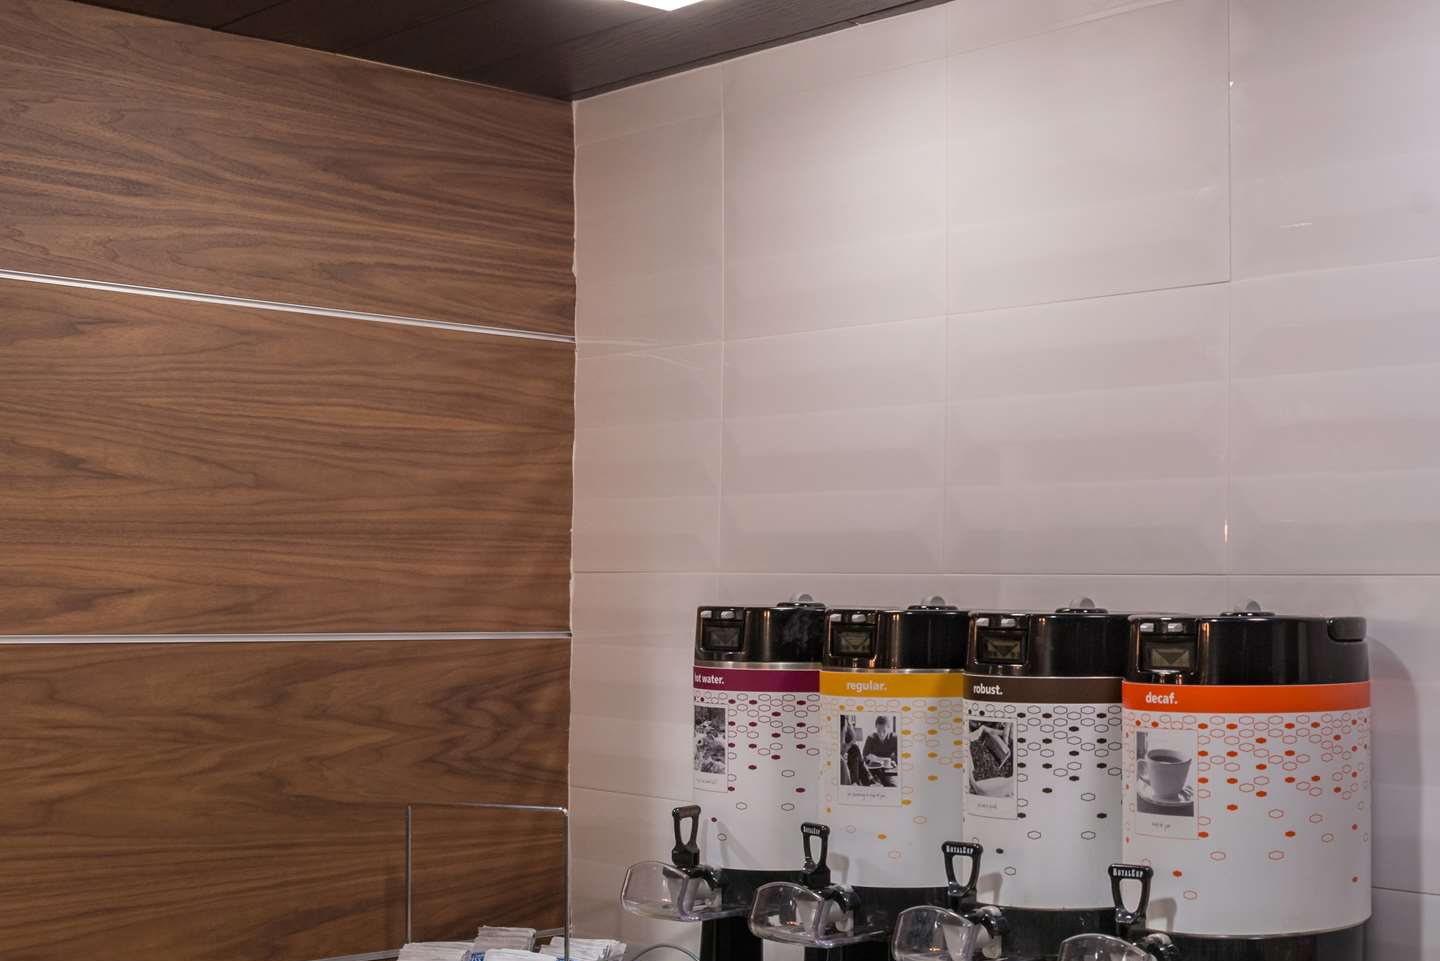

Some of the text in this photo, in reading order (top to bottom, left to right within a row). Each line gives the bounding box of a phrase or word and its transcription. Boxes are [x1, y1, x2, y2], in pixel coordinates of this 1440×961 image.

[702, 675, 725, 685] water.
[846, 680, 888, 692] regular.
[973, 683, 1004, 695] robust.
[1145, 691, 1179, 705] decaf.
